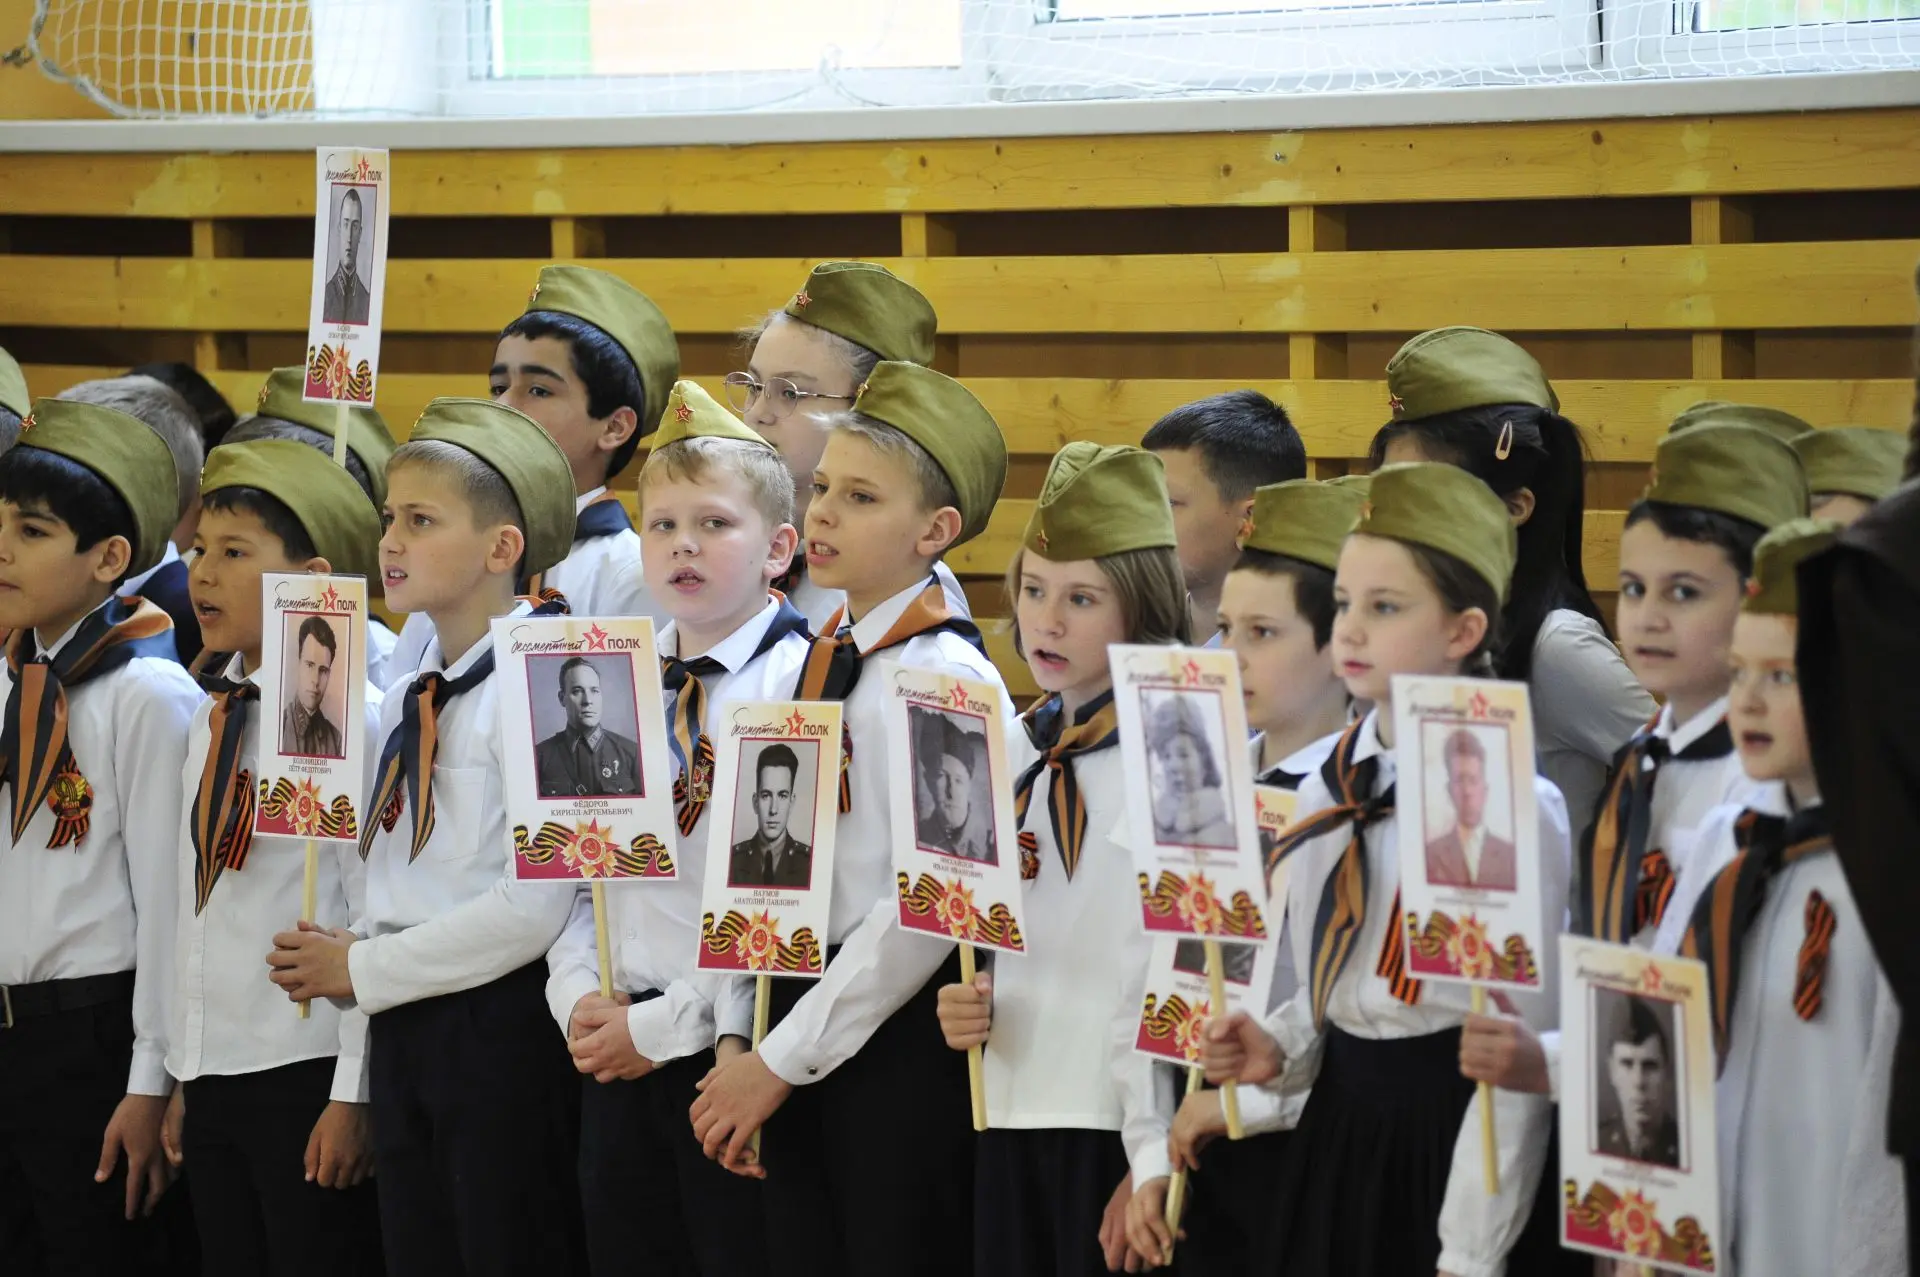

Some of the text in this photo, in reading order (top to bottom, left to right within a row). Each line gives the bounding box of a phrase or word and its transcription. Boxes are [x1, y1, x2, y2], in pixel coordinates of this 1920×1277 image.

[336, 600, 357, 611] ПОЛК
[607, 638, 641, 649] ПОЛК
[967, 700, 992, 715] ПОЛК
[802, 724, 829, 736] ПОЛК
[572, 799, 609, 808] ФЁДОРОВ
[583, 807, 633, 816] АРТЕМЬЕВИЧ
[753, 889, 780, 897] НАУМОВ
